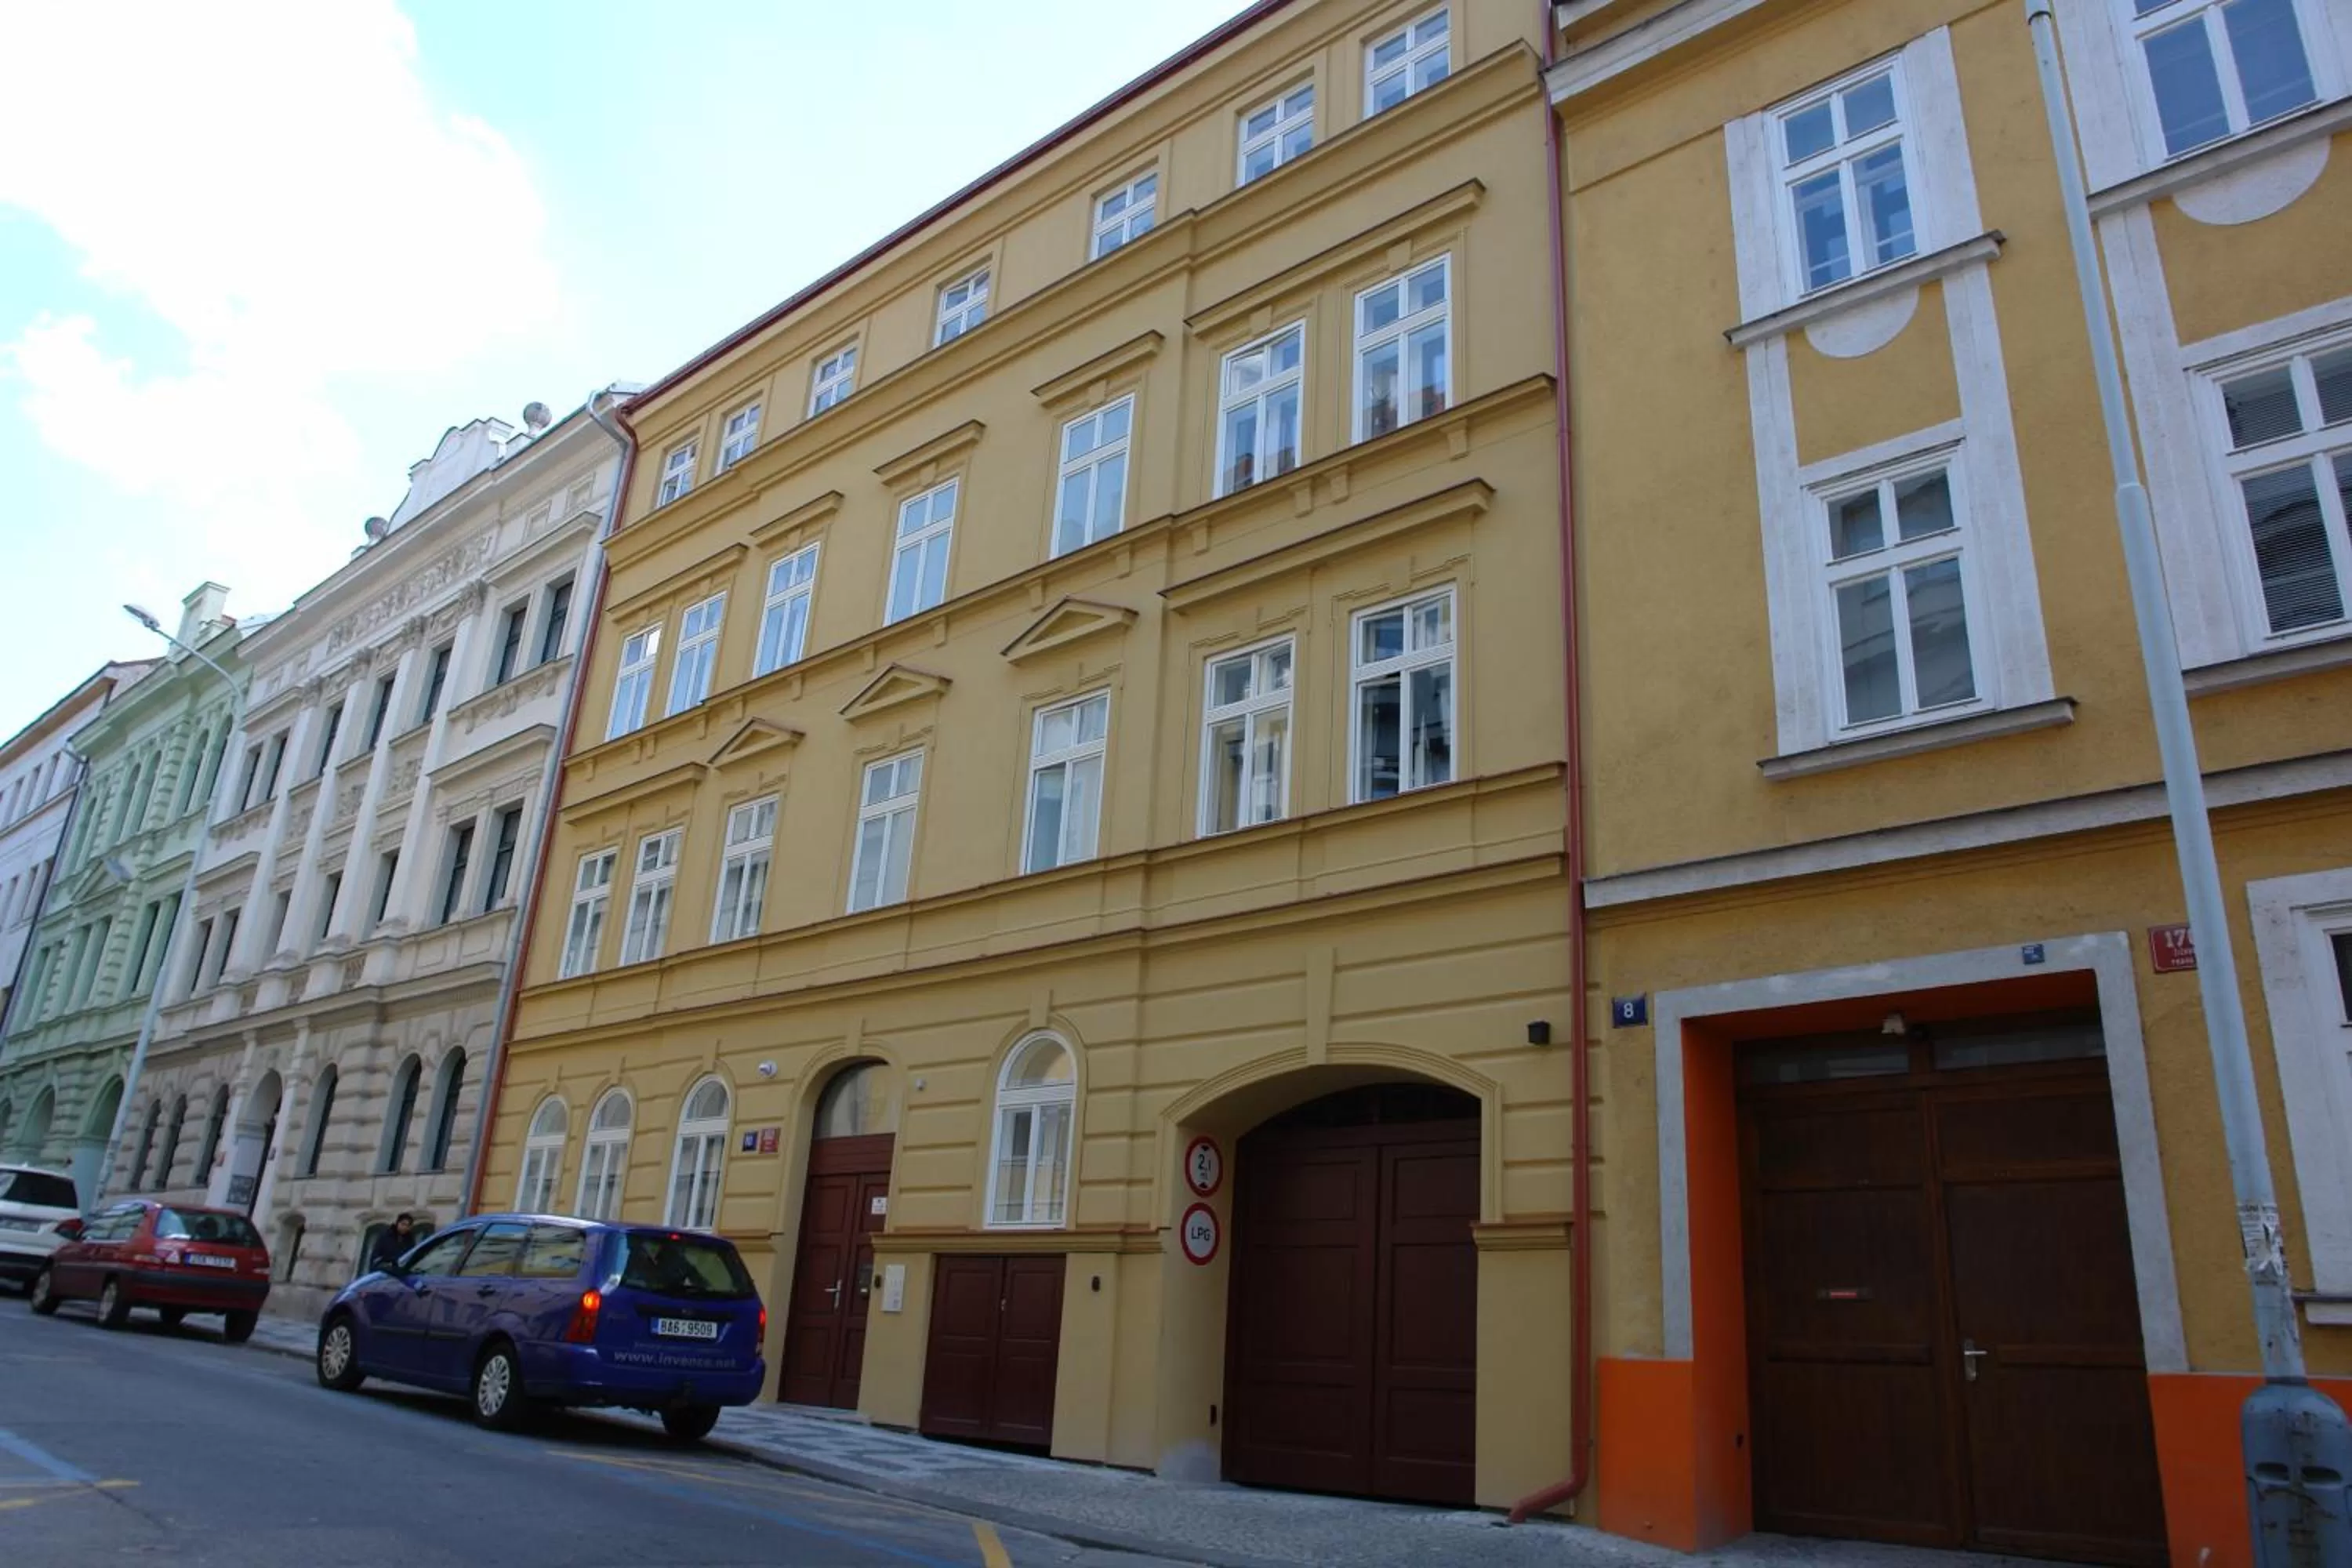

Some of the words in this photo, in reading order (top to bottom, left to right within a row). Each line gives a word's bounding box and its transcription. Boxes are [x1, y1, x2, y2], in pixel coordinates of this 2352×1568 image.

[1624, 1003, 1634, 1018] 8
[1191, 1226, 1212, 1241] LPG
[660, 1320, 680, 1334] 8A6
[687, 1323, 713, 1337] 9509
